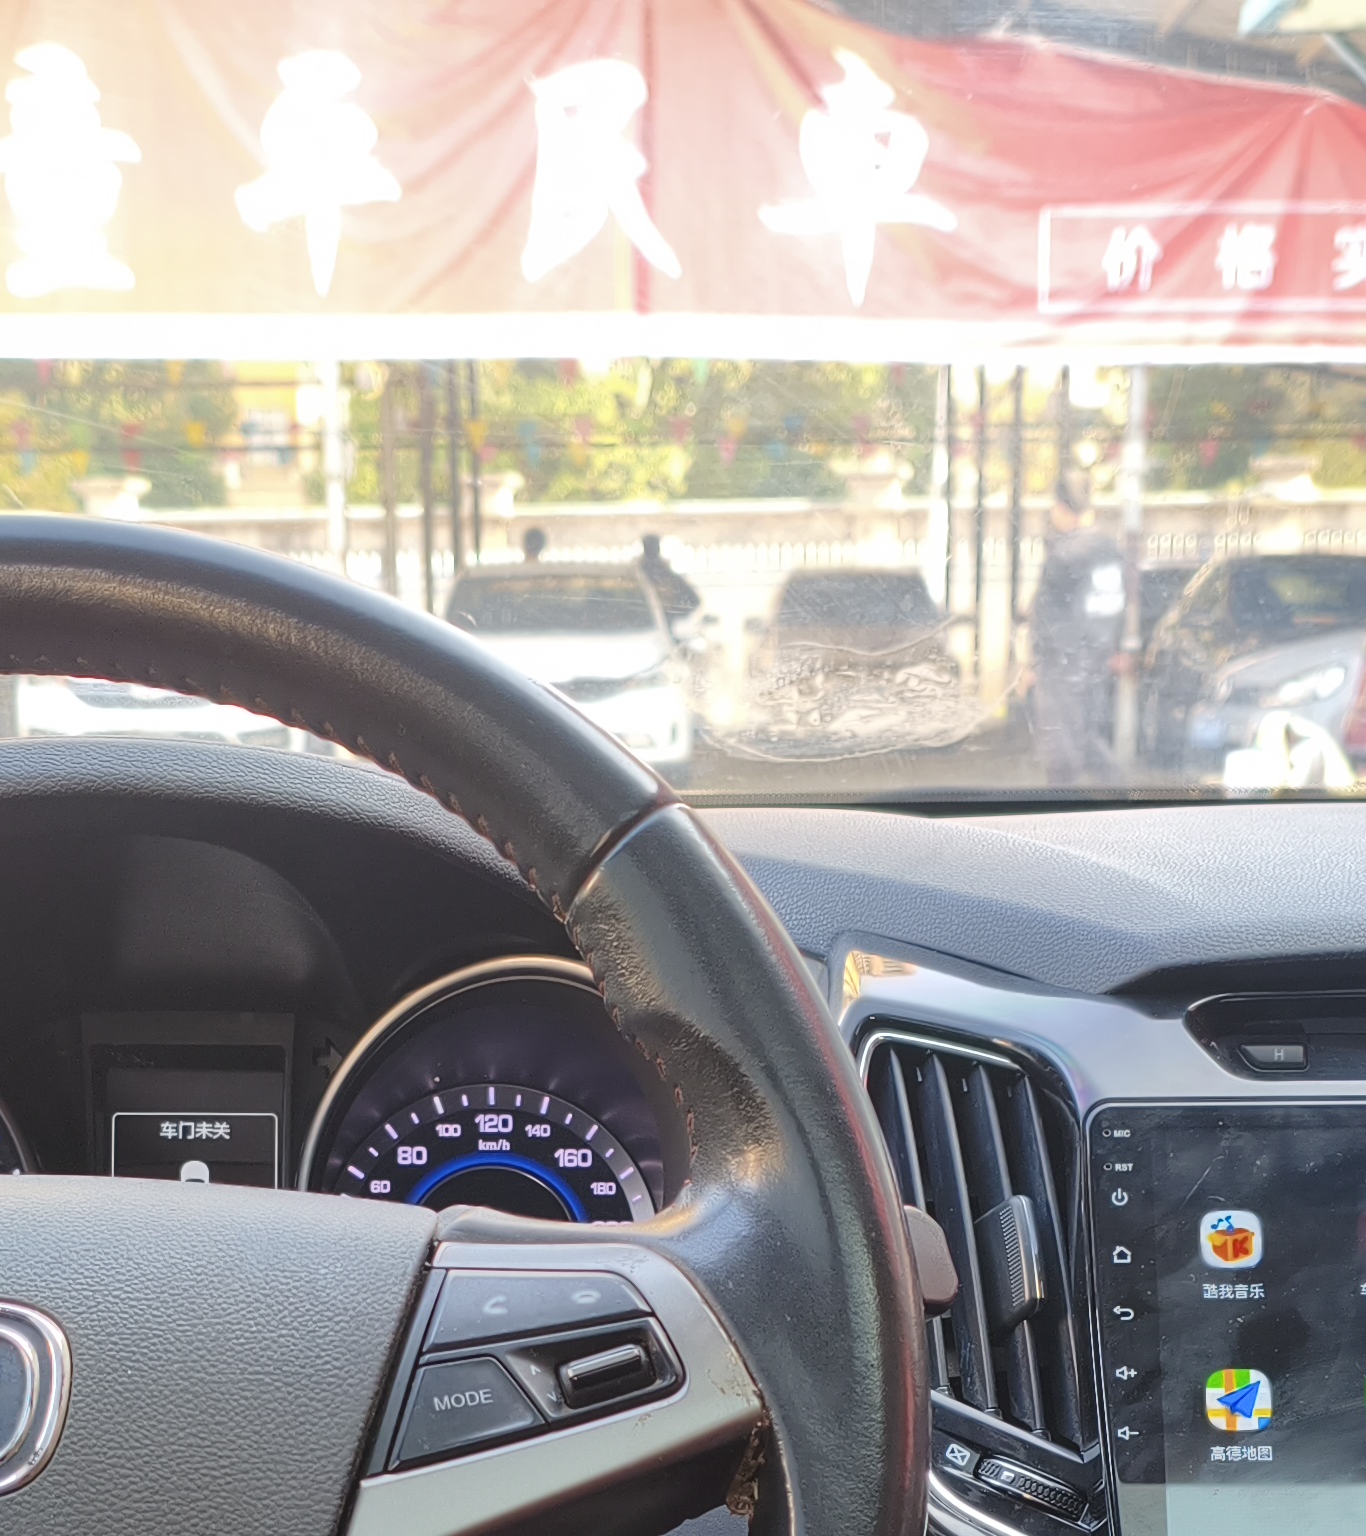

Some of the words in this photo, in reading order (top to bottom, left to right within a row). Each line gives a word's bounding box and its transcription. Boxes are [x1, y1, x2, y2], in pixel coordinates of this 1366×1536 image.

[160, 1121, 230, 1139] 车门未关
[435, 1124, 461, 1137] 100
[474, 1114, 513, 1133] 120
[525, 1124, 551, 1137] 140
[1113, 1129, 1131, 1138] MIC
[478, 1139, 510, 1151] km/h
[397, 1146, 428, 1165] 80
[554, 1148, 592, 1168] 160
[1114, 1163, 1133, 1172] RST
[370, 1180, 391, 1194] 60
[590, 1182, 616, 1196] 180
[1202, 1283, 1265, 1299] 酷我音乐
[433, 1389, 494, 1412] MODE
[1210, 1446, 1273, 1461] 高德地图
